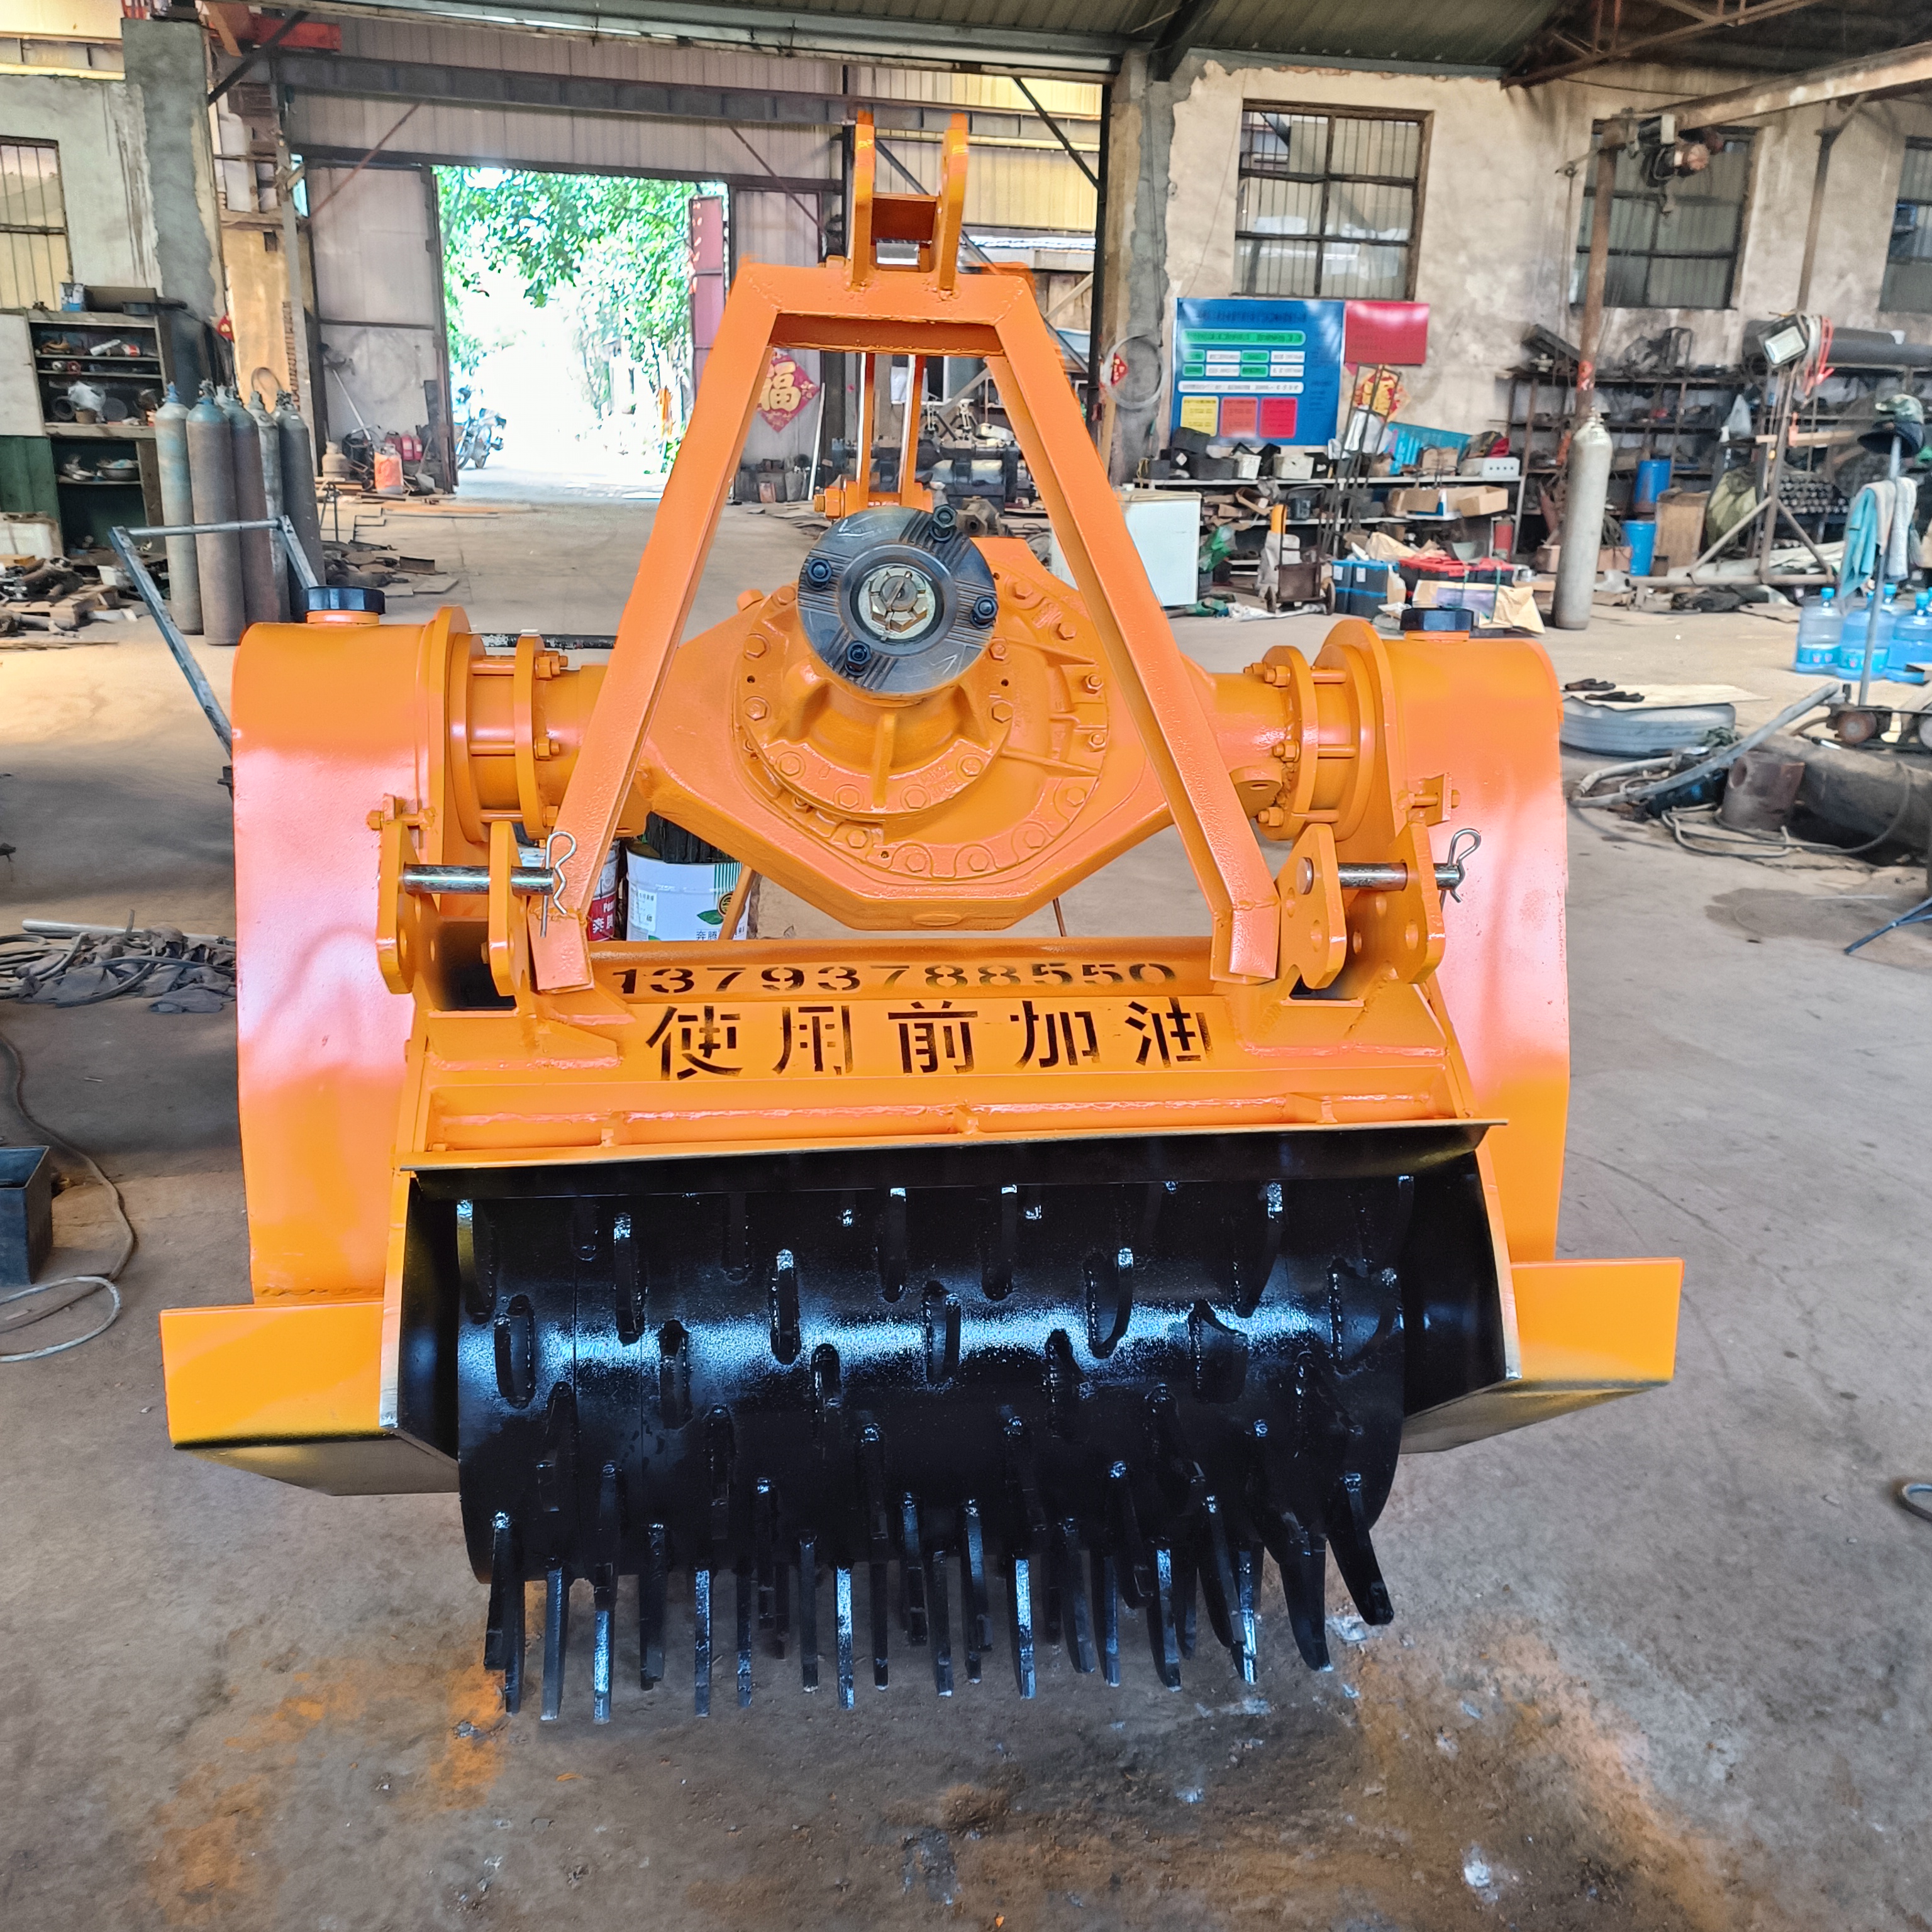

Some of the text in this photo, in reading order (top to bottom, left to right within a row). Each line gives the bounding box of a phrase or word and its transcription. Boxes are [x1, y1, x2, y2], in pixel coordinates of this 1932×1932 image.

[613, 962, 1177, 994] 13793788550
[645, 997, 1214, 1080] 使用前加油
